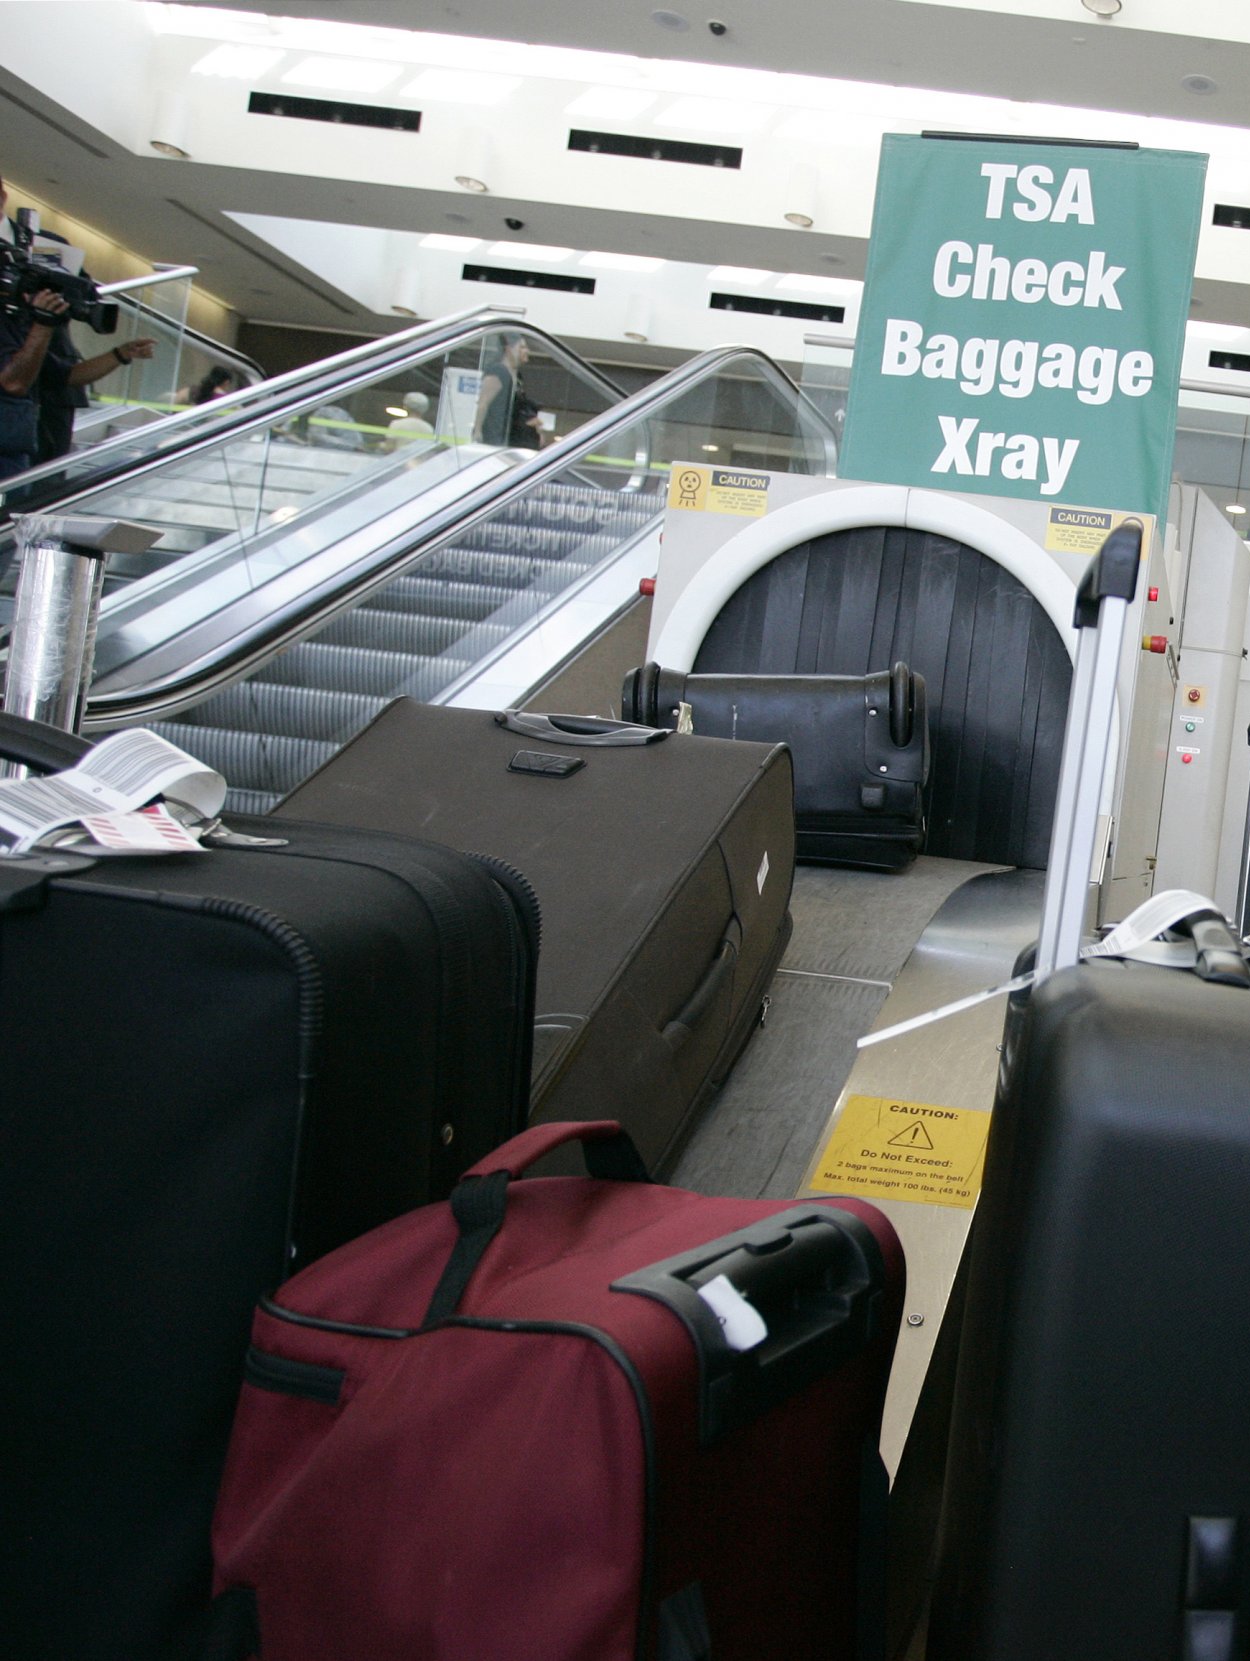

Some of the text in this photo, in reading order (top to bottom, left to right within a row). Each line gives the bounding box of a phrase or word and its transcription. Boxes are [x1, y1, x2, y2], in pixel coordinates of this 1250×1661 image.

[980, 162, 1095, 226] TSA
[932, 240, 1127, 311] Check
[880, 318, 1154, 405] Baggage
[930, 415, 1080, 495] Xray
[719, 475, 766, 488] CAUTION
[1057, 512, 1106, 526] CAUTION
[889, 1105, 959, 1121] CAUTION:
[860, 1149, 953, 1169] Do Not Exceed:
[845, 1162, 868, 1171] bags
[869, 1165, 913, 1176] maximum
[929, 1171, 944, 1180] the
[946, 1174, 965, 1183] belt
[823, 1172, 971, 1198] Max. total weight 100 lbs. (45 kg)
